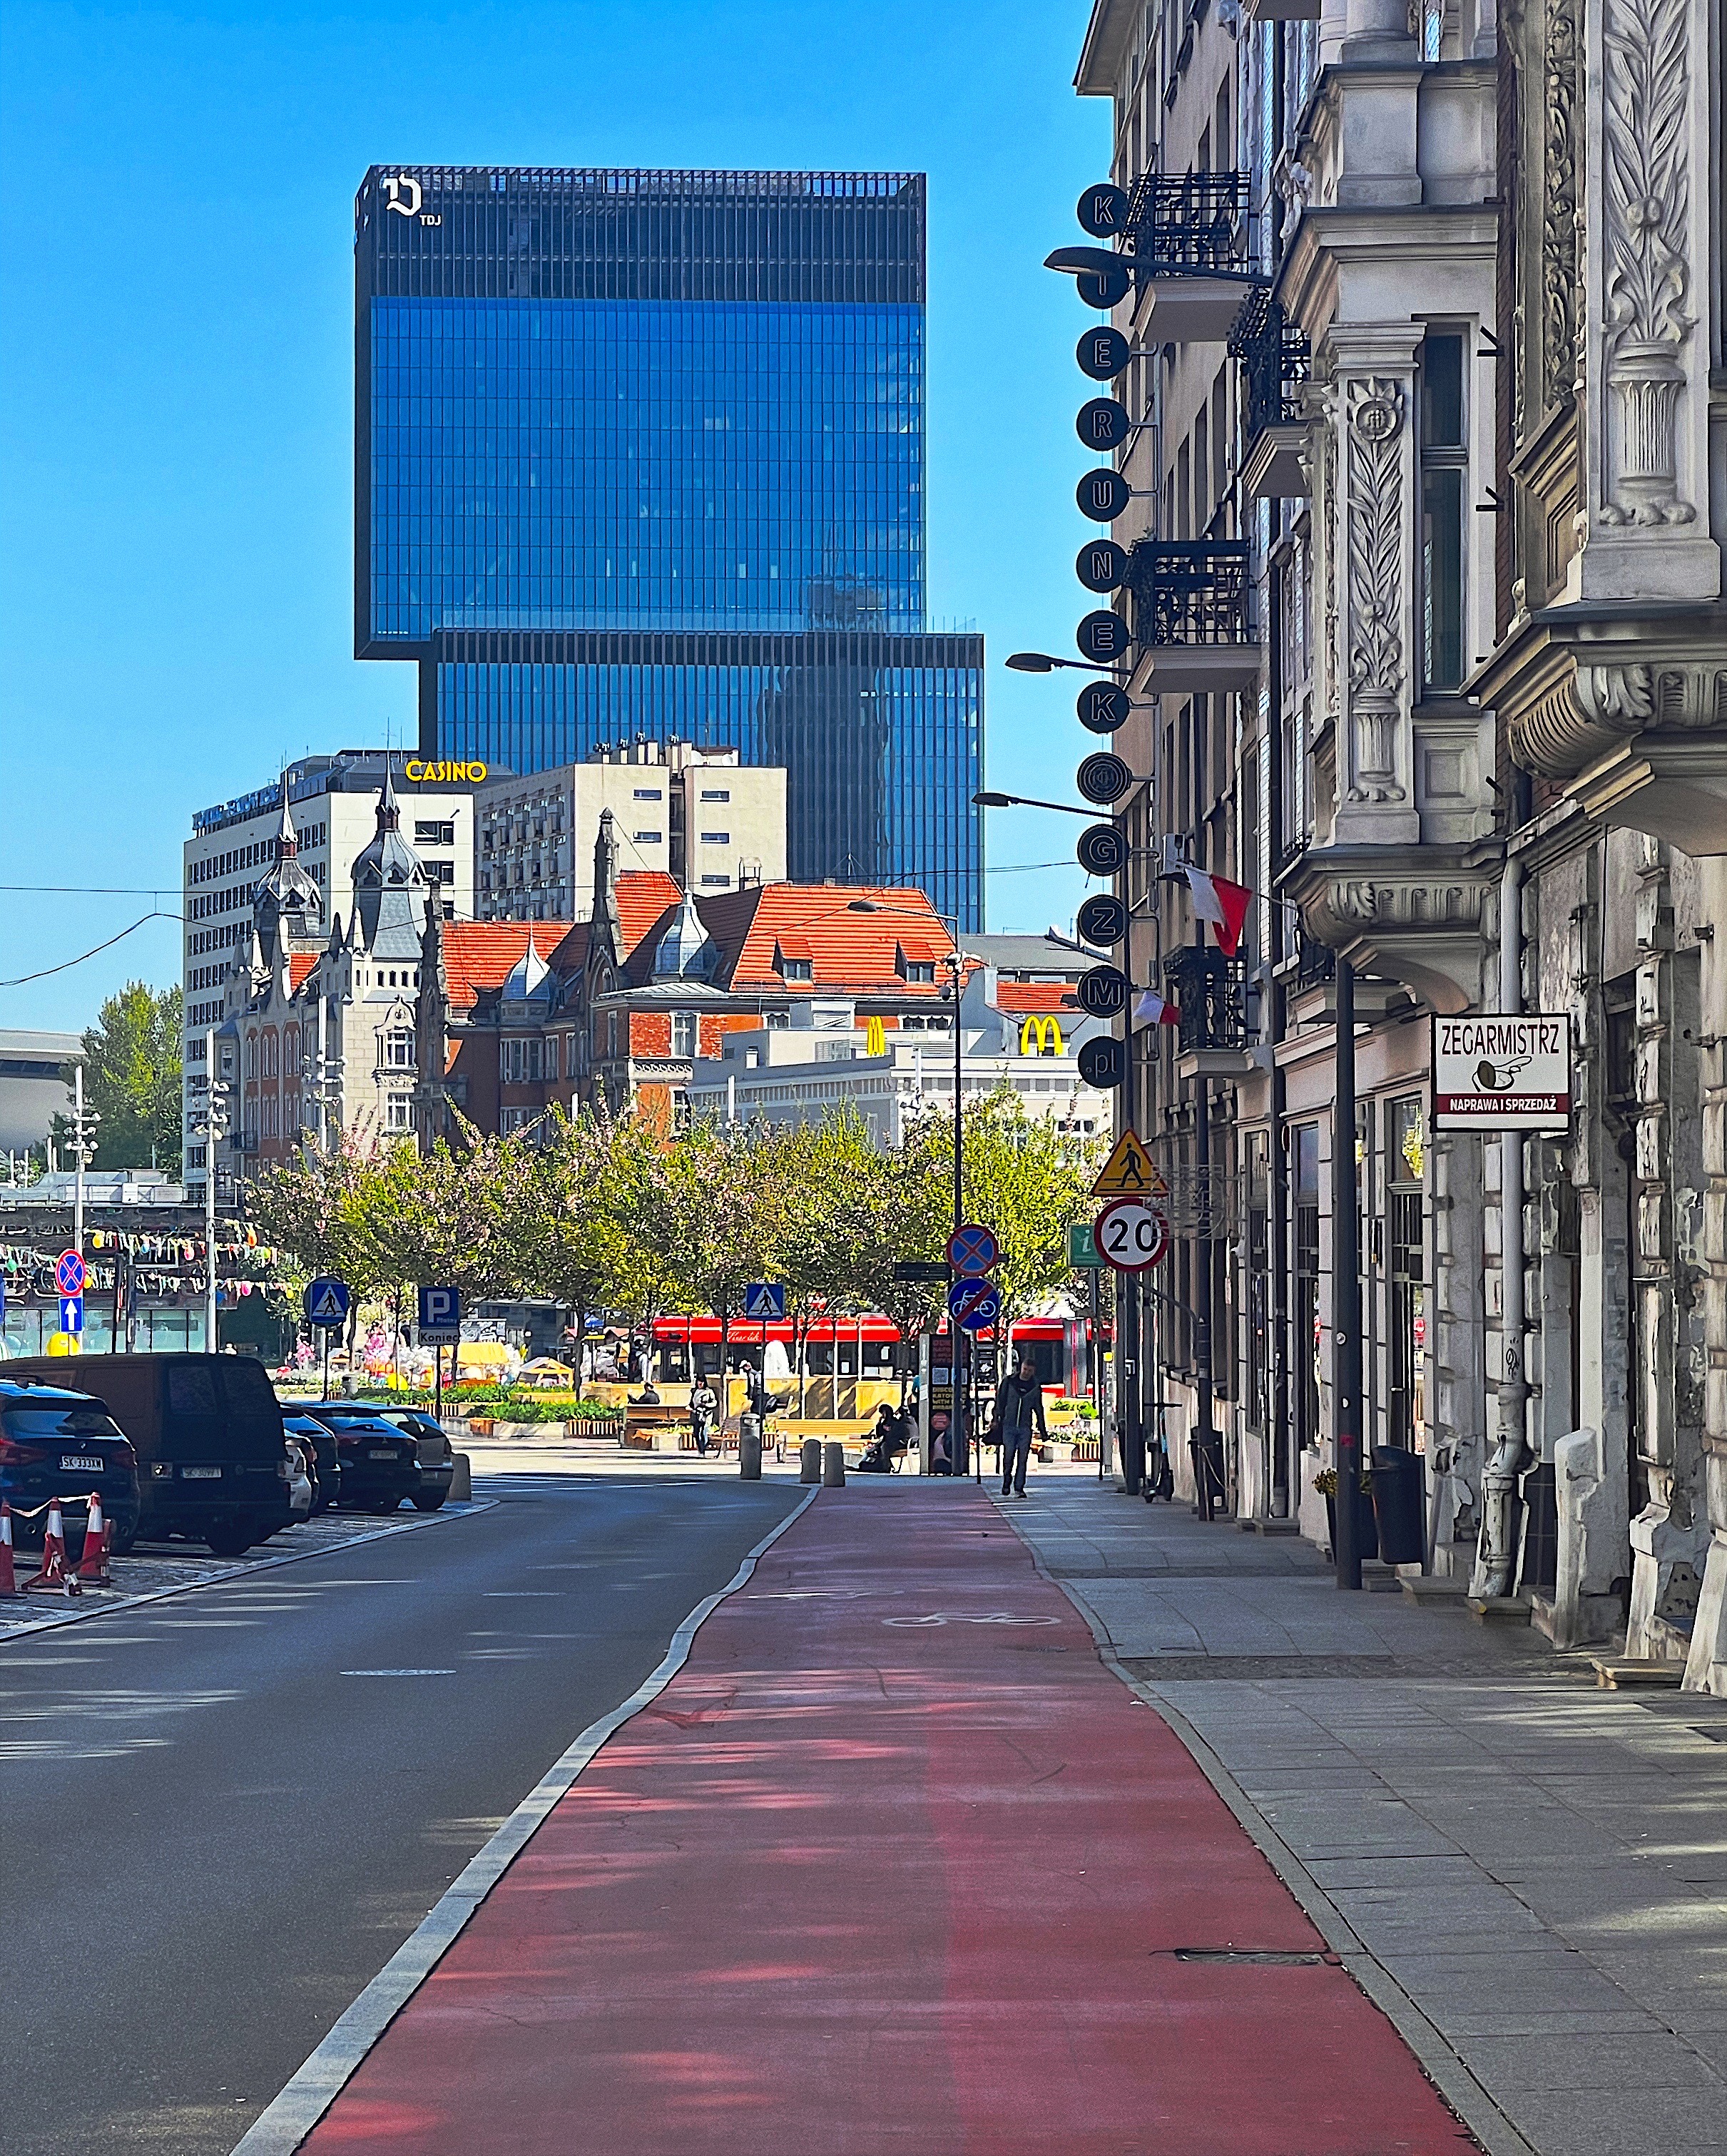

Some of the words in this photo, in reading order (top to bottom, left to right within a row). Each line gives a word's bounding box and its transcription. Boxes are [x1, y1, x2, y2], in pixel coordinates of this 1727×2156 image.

[419, 215, 442, 226] TDJ
[405, 760, 488, 782] CASINO
[1442, 1024, 1559, 1056] ZEGARMISTRZ
[1450, 1098, 1499, 1110] NAPRAWA
[1500, 1098, 1504, 1110] I
[1505, 1095, 1557, 1111] SPRZEDAŻ
[1108, 1218, 1158, 1252] 20
[427, 1291, 450, 1323] P
[420, 1332, 459, 1342] Koniec
[63, 1456, 75, 1467] SK
